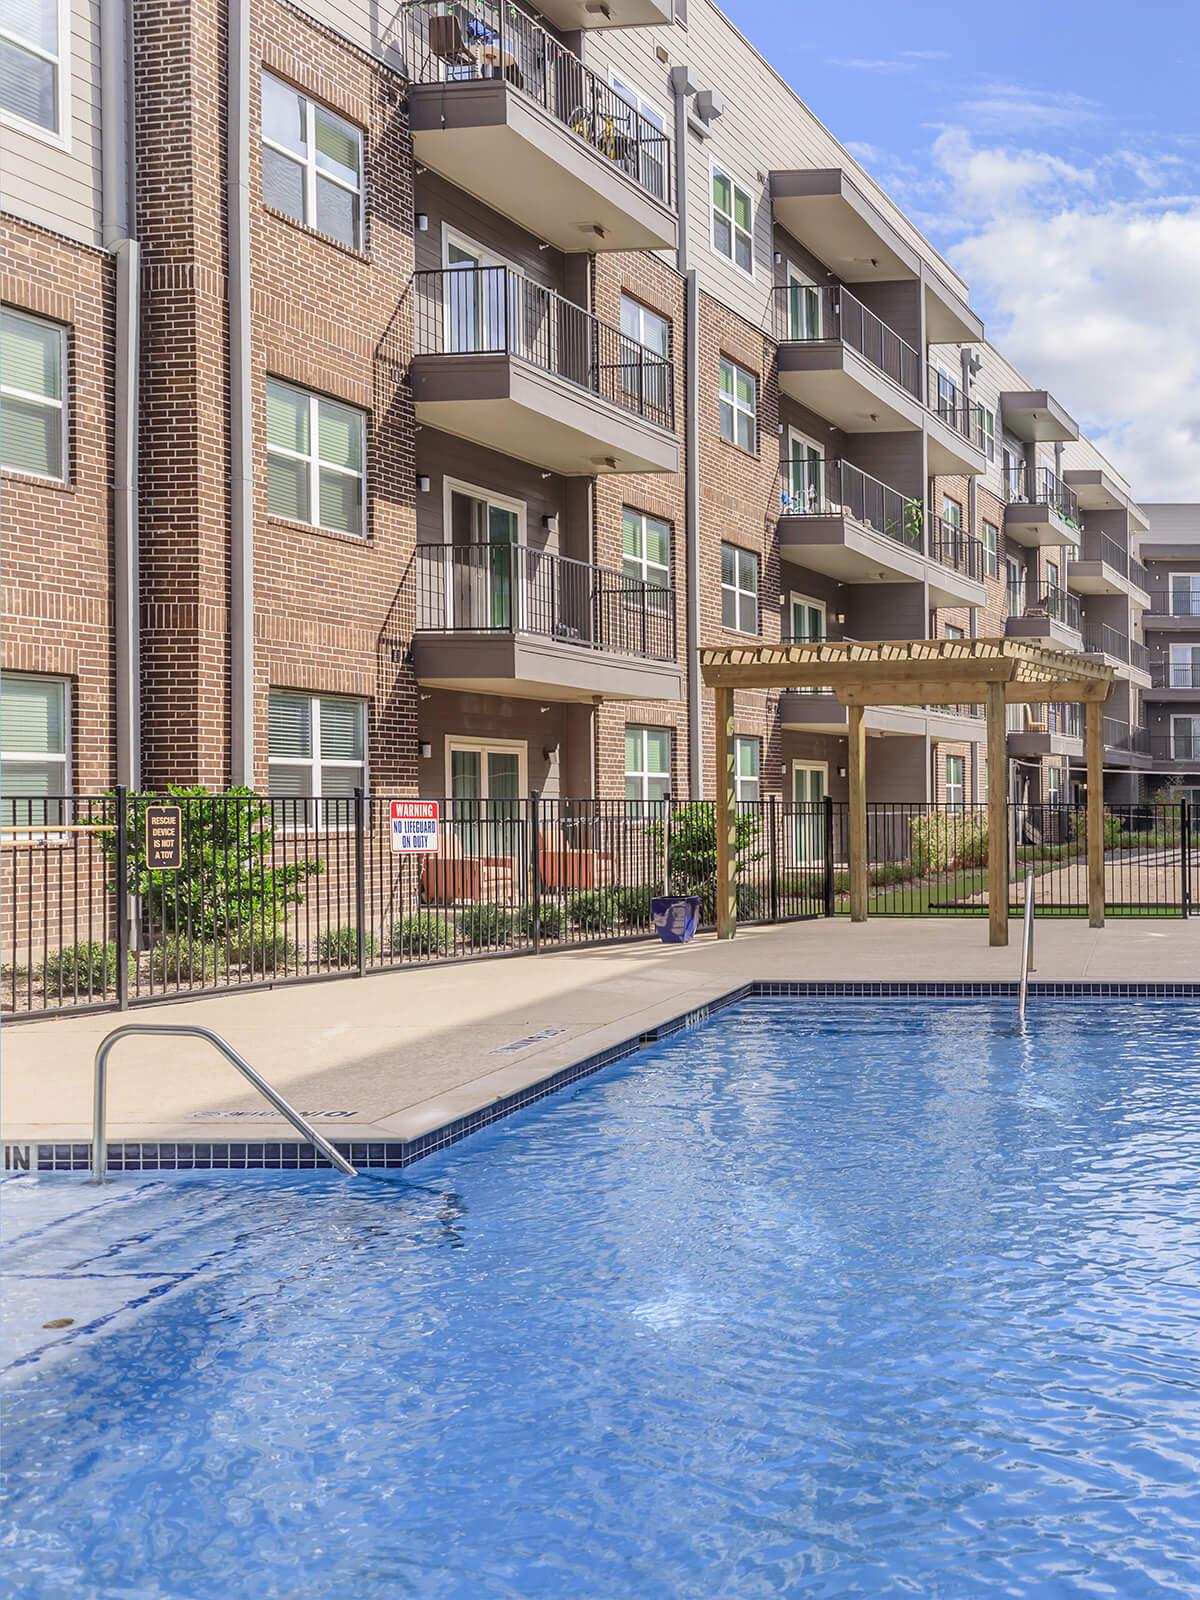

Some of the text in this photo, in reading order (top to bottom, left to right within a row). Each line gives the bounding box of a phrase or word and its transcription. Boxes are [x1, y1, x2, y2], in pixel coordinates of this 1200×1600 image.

[396, 803, 433, 817] WARNING
[151, 816, 177, 825] RESCUE
[152, 828, 175, 837] DEVICE
[393, 820, 436, 834] NO LIFEGUARD
[153, 839, 174, 848] IS NOT
[402, 835, 428, 848] ON DUTY
[154, 850, 173, 859] A TOY
[5, 1145, 30, 1170] IN
